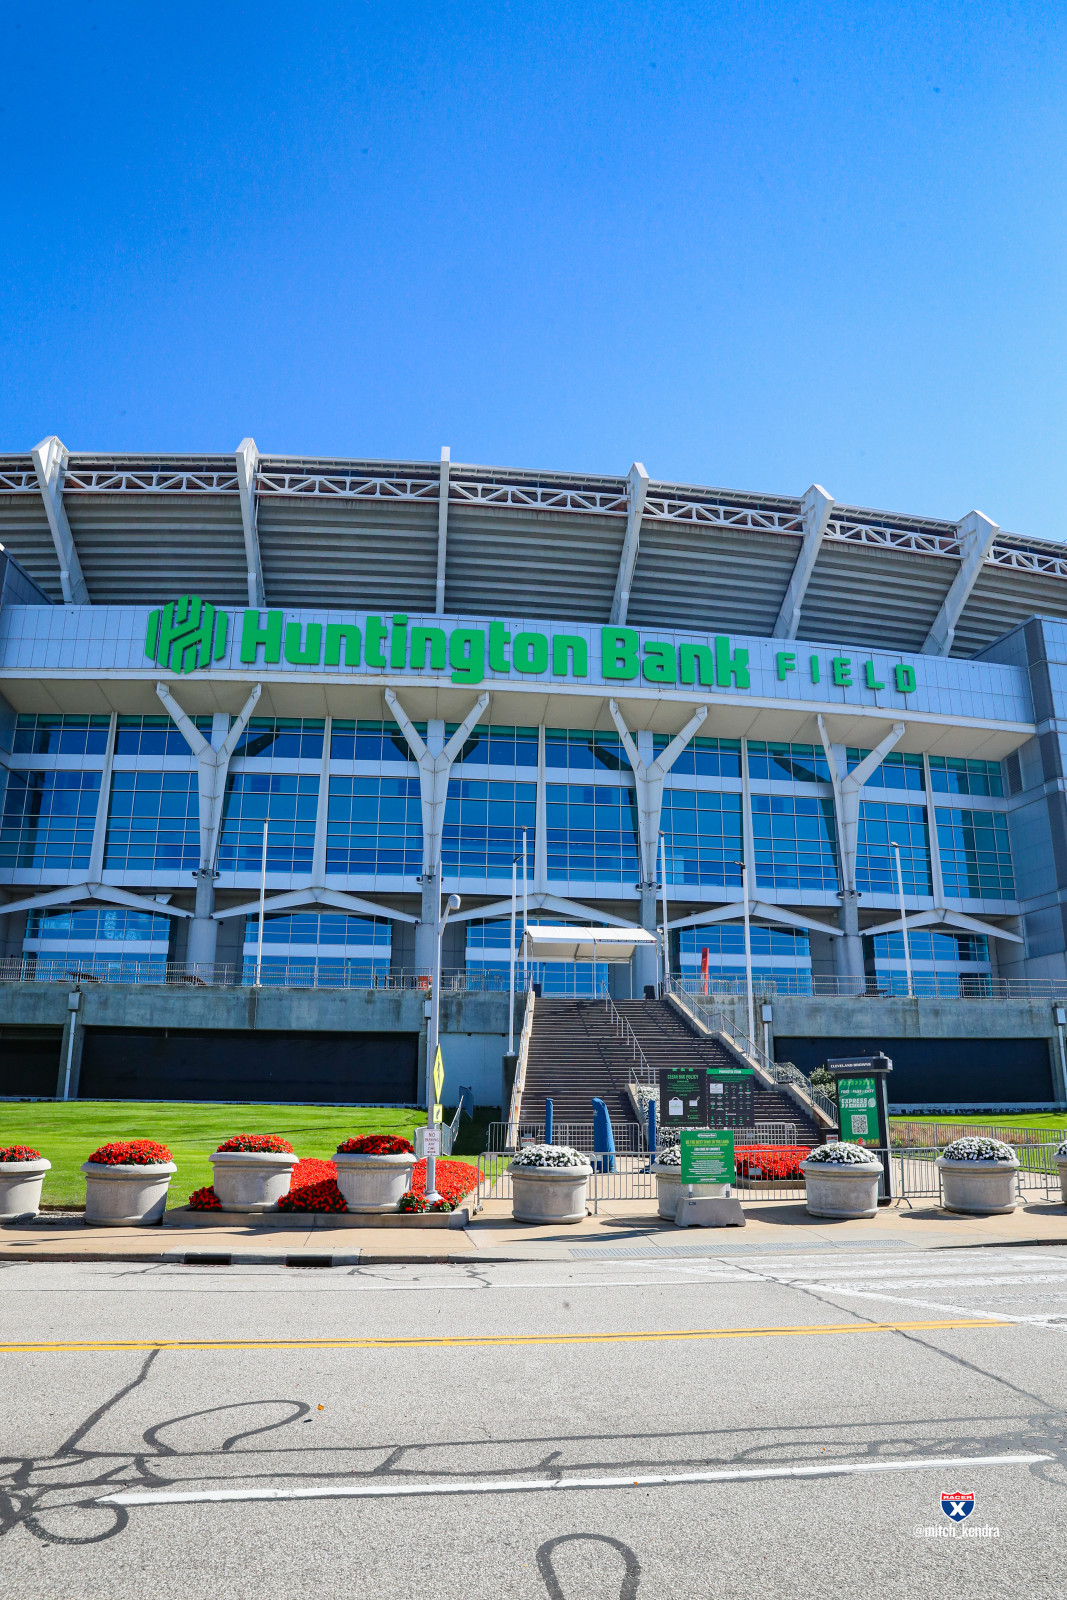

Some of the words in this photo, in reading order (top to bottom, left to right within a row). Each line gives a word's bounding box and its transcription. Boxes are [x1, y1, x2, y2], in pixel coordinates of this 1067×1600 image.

[240, 609, 588, 685] Huntington
[602, 626, 750, 689] Bank
[777, 652, 916, 693] FIELD
